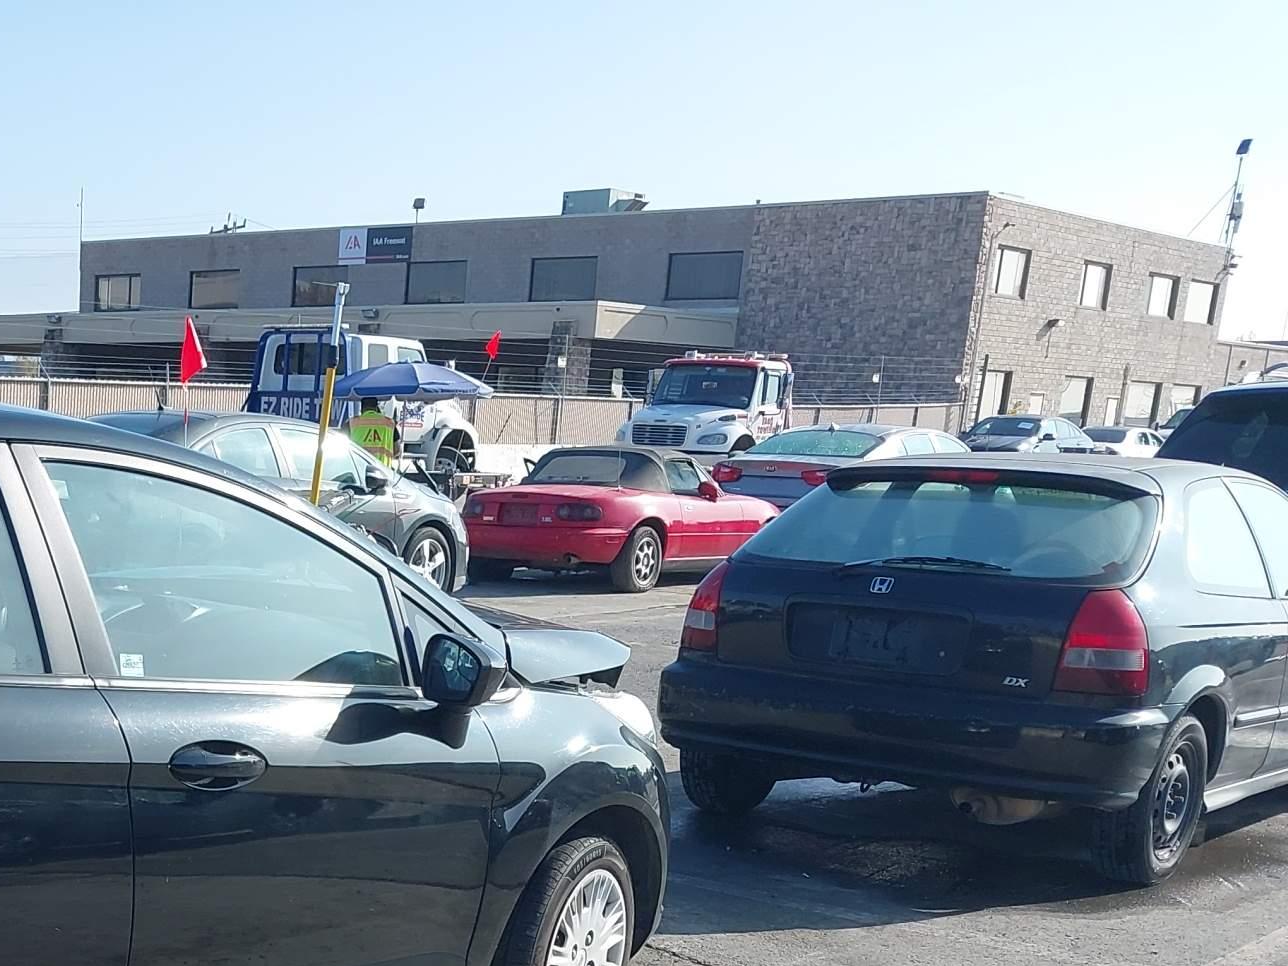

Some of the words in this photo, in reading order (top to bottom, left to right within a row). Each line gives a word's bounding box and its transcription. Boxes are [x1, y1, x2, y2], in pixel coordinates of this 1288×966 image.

[260, 396, 277, 415] EZ
[280, 397, 310, 419] RIDE
[313, 397, 343, 420] TW
[1002, 676, 1030, 688] DX
